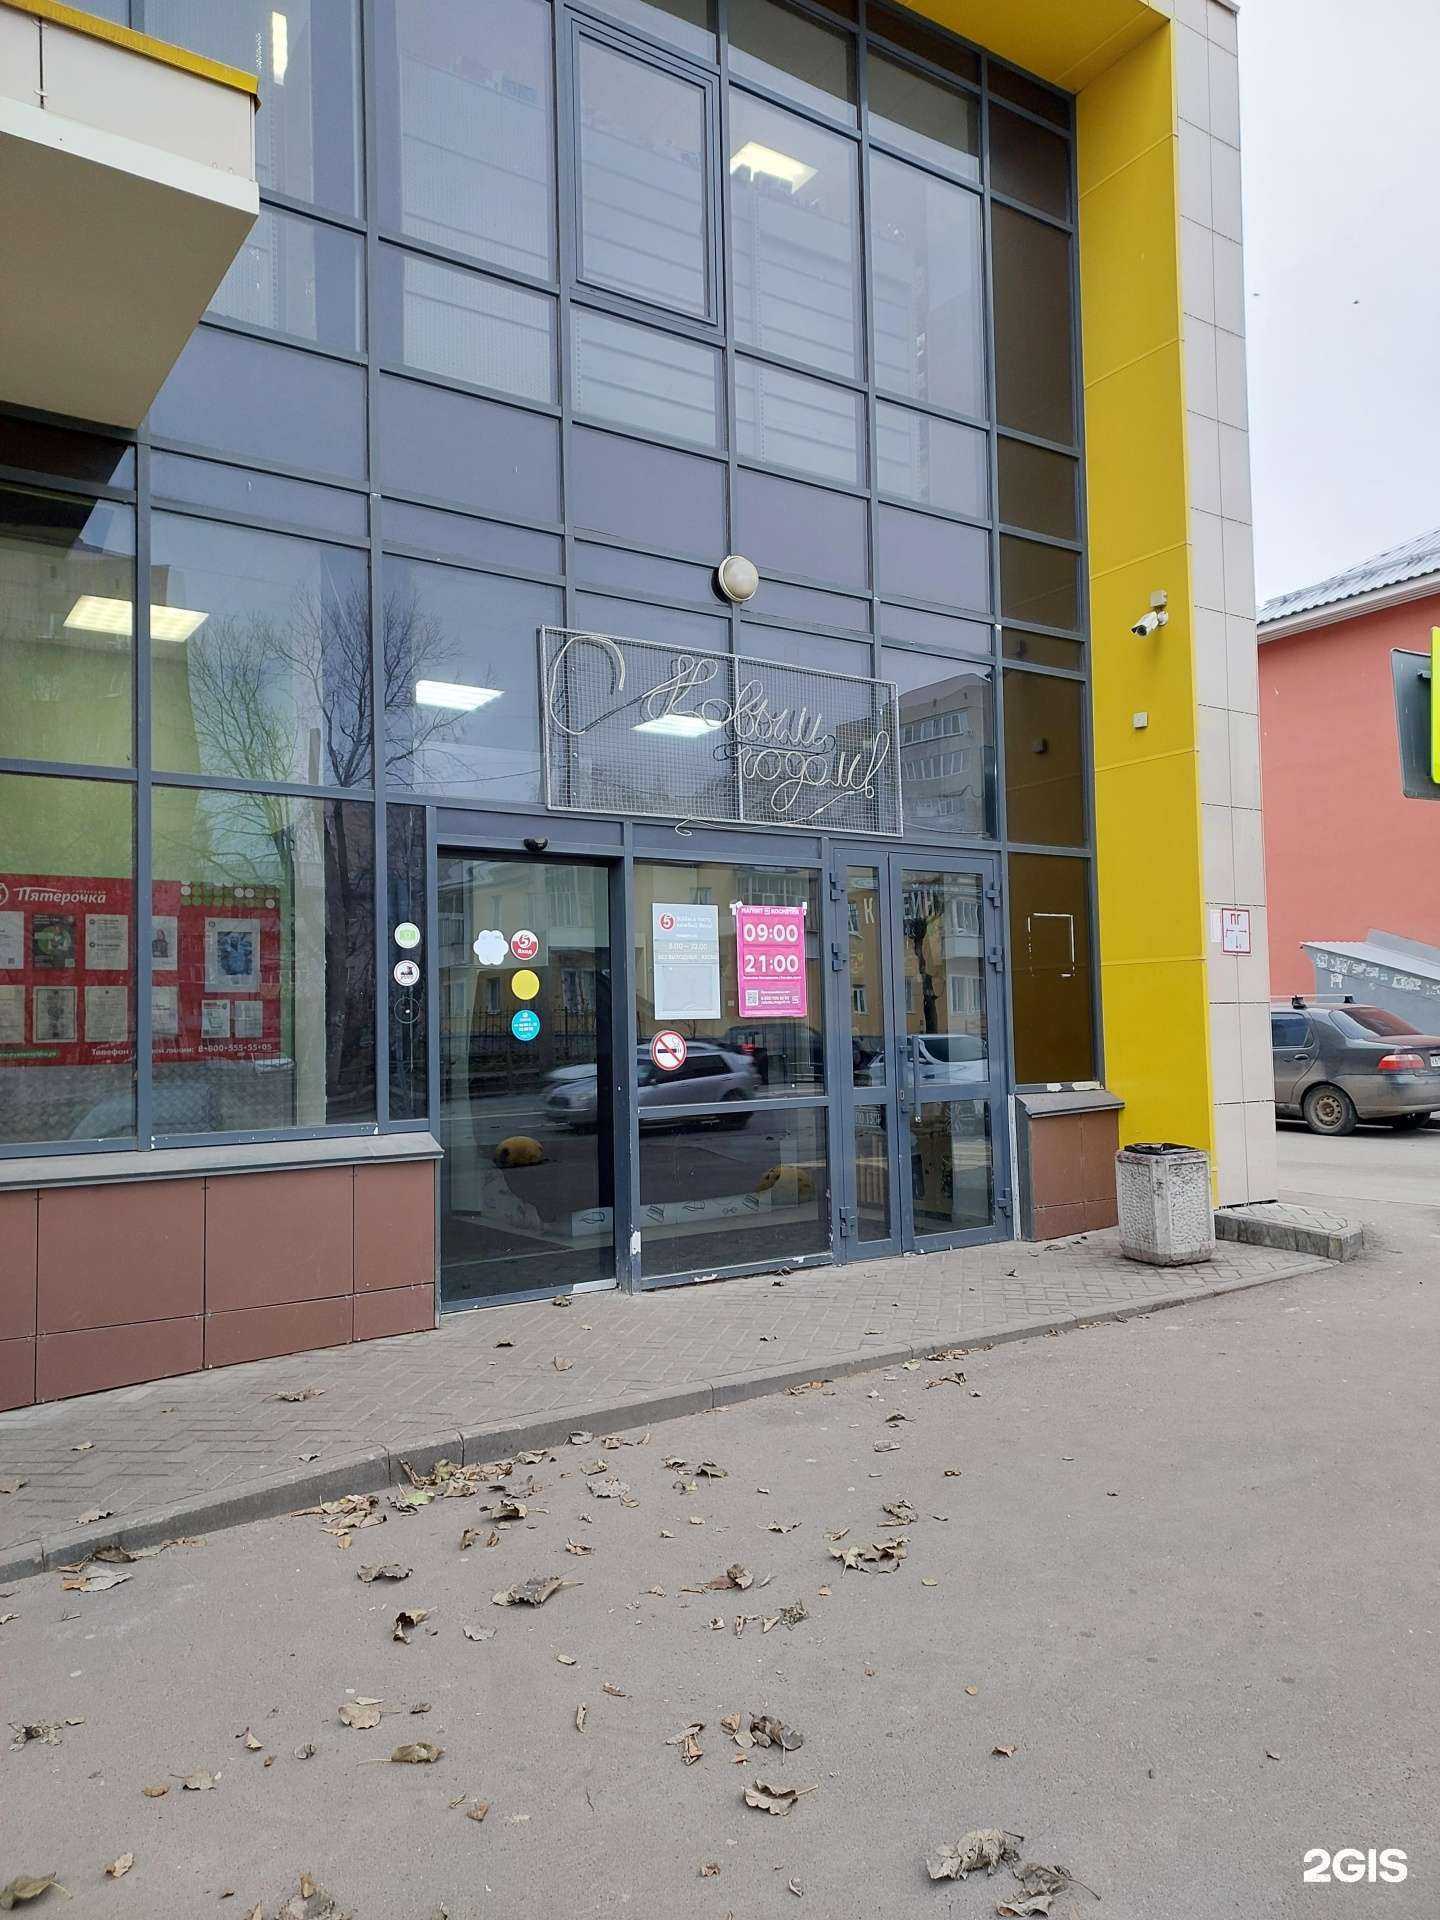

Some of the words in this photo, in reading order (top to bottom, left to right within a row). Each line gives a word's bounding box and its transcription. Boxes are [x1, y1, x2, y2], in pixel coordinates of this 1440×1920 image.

[13, 886, 107, 905] Пятерочка
[743, 923, 798, 942] 09:00
[744, 954, 799, 973] 21:00
